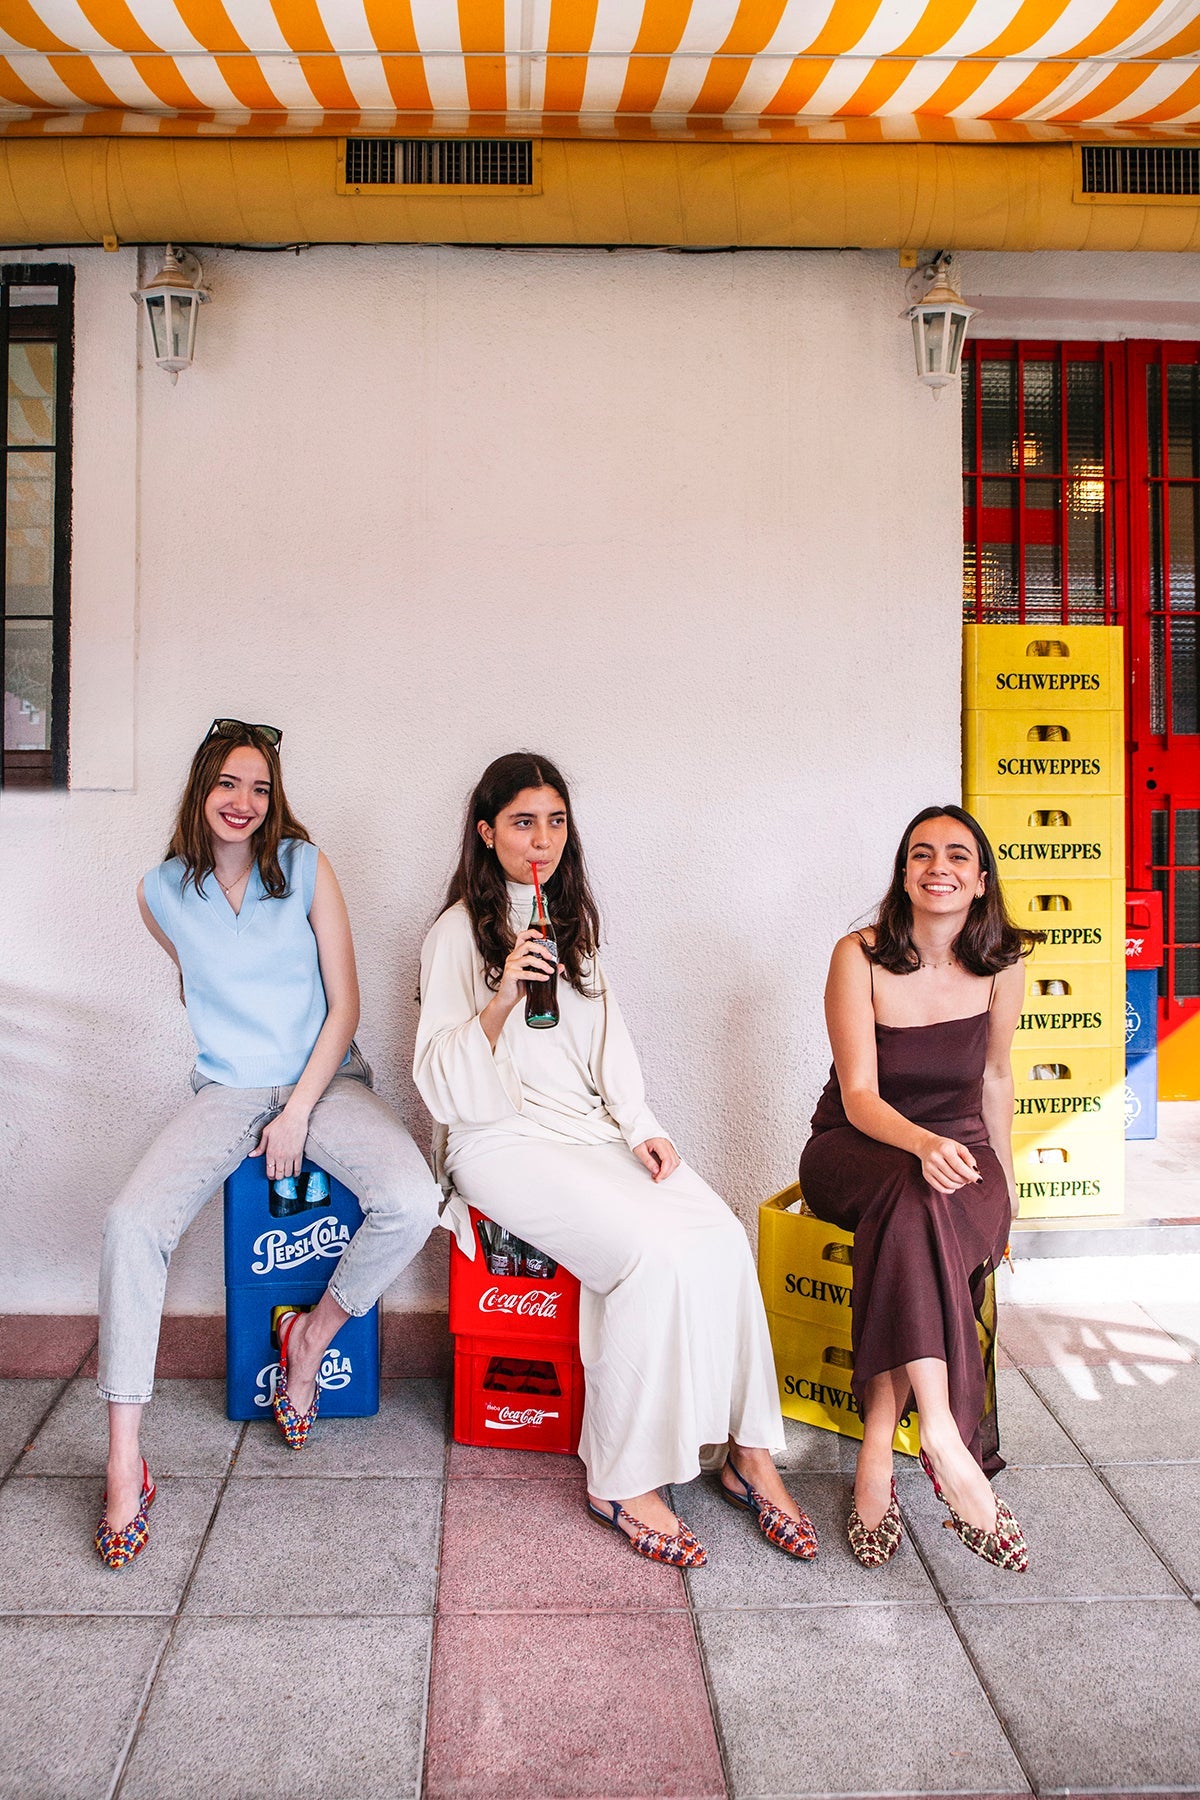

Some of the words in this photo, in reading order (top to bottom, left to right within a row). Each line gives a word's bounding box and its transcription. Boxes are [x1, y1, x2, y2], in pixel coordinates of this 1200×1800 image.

[996, 673, 1100, 690] SCHWEPPES
[997, 758, 1100, 775] SCHWEPPES
[998, 843, 1101, 860] SCHWEPPES
[1015, 1012, 1102, 1030] HWEPPES
[1013, 1096, 1101, 1115] HWEPPES
[1015, 1179, 1100, 1198] HWEPPES
[478, 1287, 562, 1319] Coca-Cola
[499, 1406, 545, 1425] Coca-Cola
